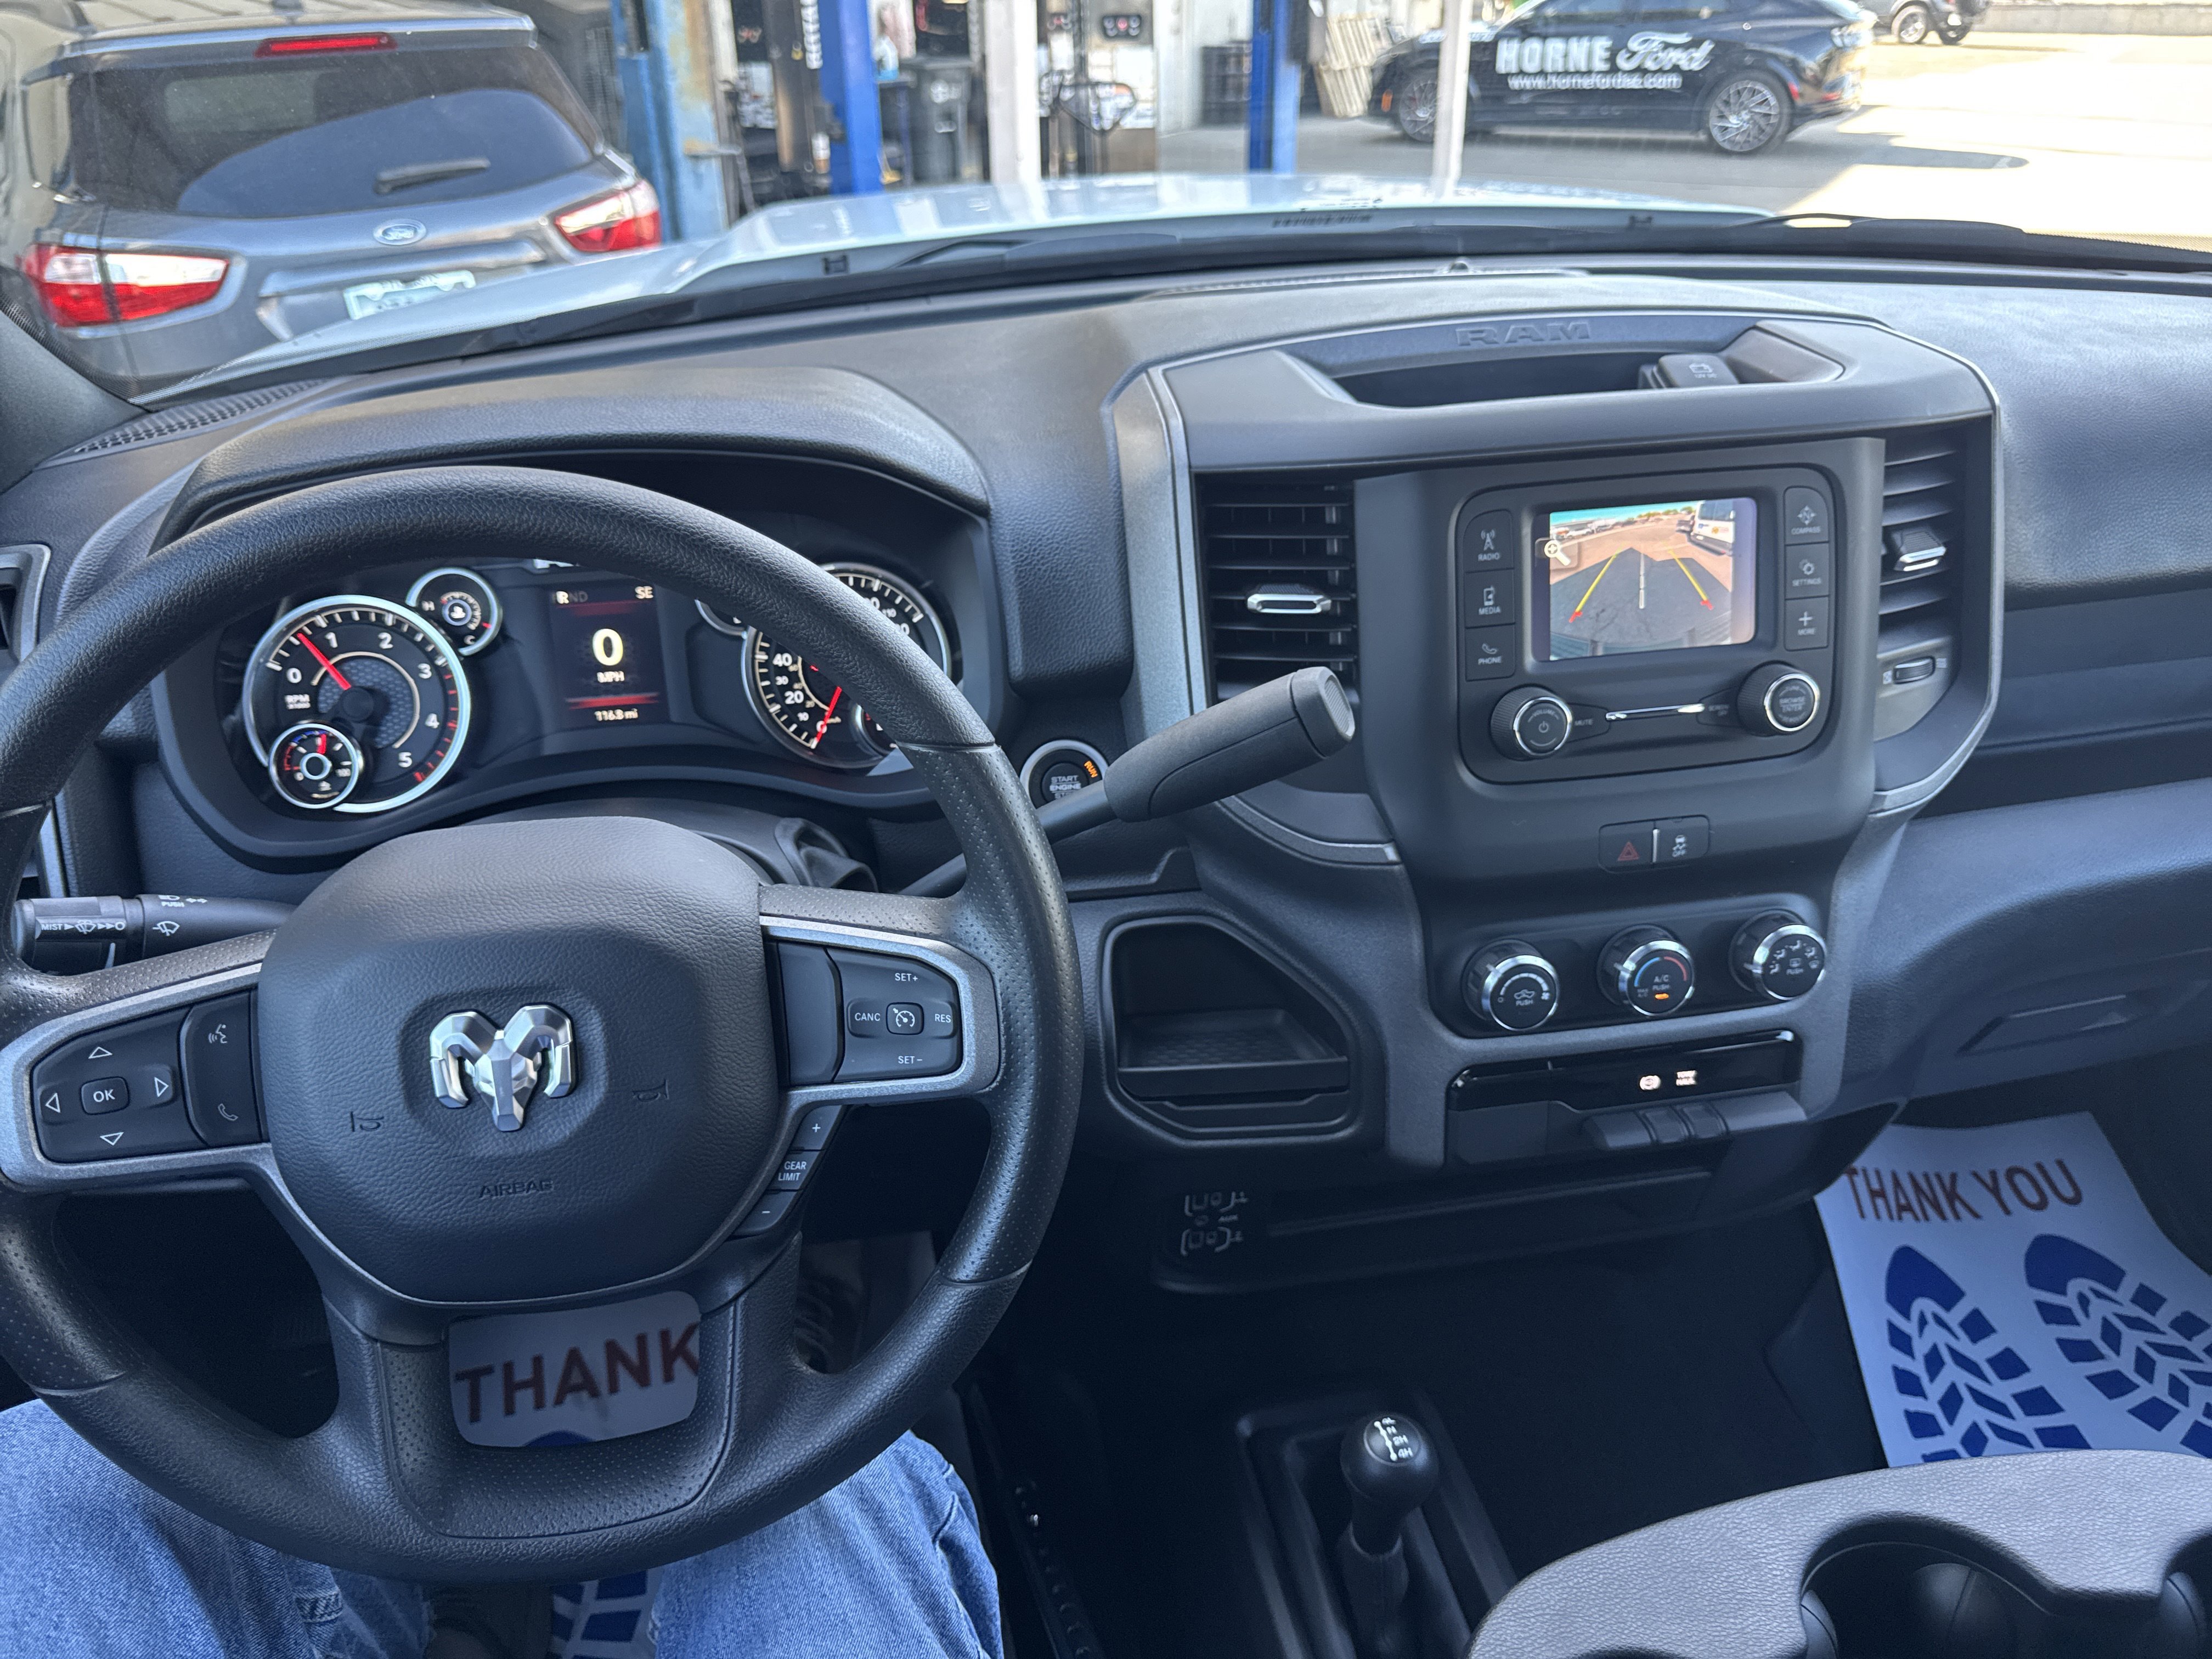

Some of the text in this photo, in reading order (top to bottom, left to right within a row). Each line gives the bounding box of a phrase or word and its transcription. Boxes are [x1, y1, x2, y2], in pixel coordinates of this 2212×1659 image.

[1496, 31, 1716, 74] HORNE Ford
[1455, 321, 1590, 347] RAM
[1478, 552, 1500, 561] RADIO
[635, 585, 653, 599] SE
[1479, 606, 1502, 615] MEDIA
[325, 632, 338, 648] 1
[377, 632, 393, 649] 2
[592, 628, 624, 666] 0
[772, 652, 793, 667] 40
[1478, 656, 1502, 665] PHONE
[286, 668, 302, 684] 0
[417, 663, 432, 679] 3
[597, 670, 624, 683] MPH
[775, 675, 789, 685] 30
[784, 690, 805, 704] 20
[424, 713, 440, 729] 4
[797, 712, 809, 721] 10
[398, 752, 413, 768] 5
[1084, 760, 1098, 778] RUN
[1051, 775, 1079, 783] START
[1049, 783, 1081, 792] ENGINE
[41, 922, 64, 932] MIST
[1654, 974, 1670, 983] A/C
[854, 1012, 881, 1022] CANC
[934, 1013, 952, 1023] RES
[93, 1089, 115, 1103] OK
[784, 1160, 807, 1170] GEAR
[778, 1172, 801, 1181] LIMIT
[478, 1180, 555, 1199] AIRBAG
[1843, 1158, 2083, 1222] THANK YOU
[454, 1321, 699, 1424] THANK
[1398, 1447, 1414, 1459] 4H
